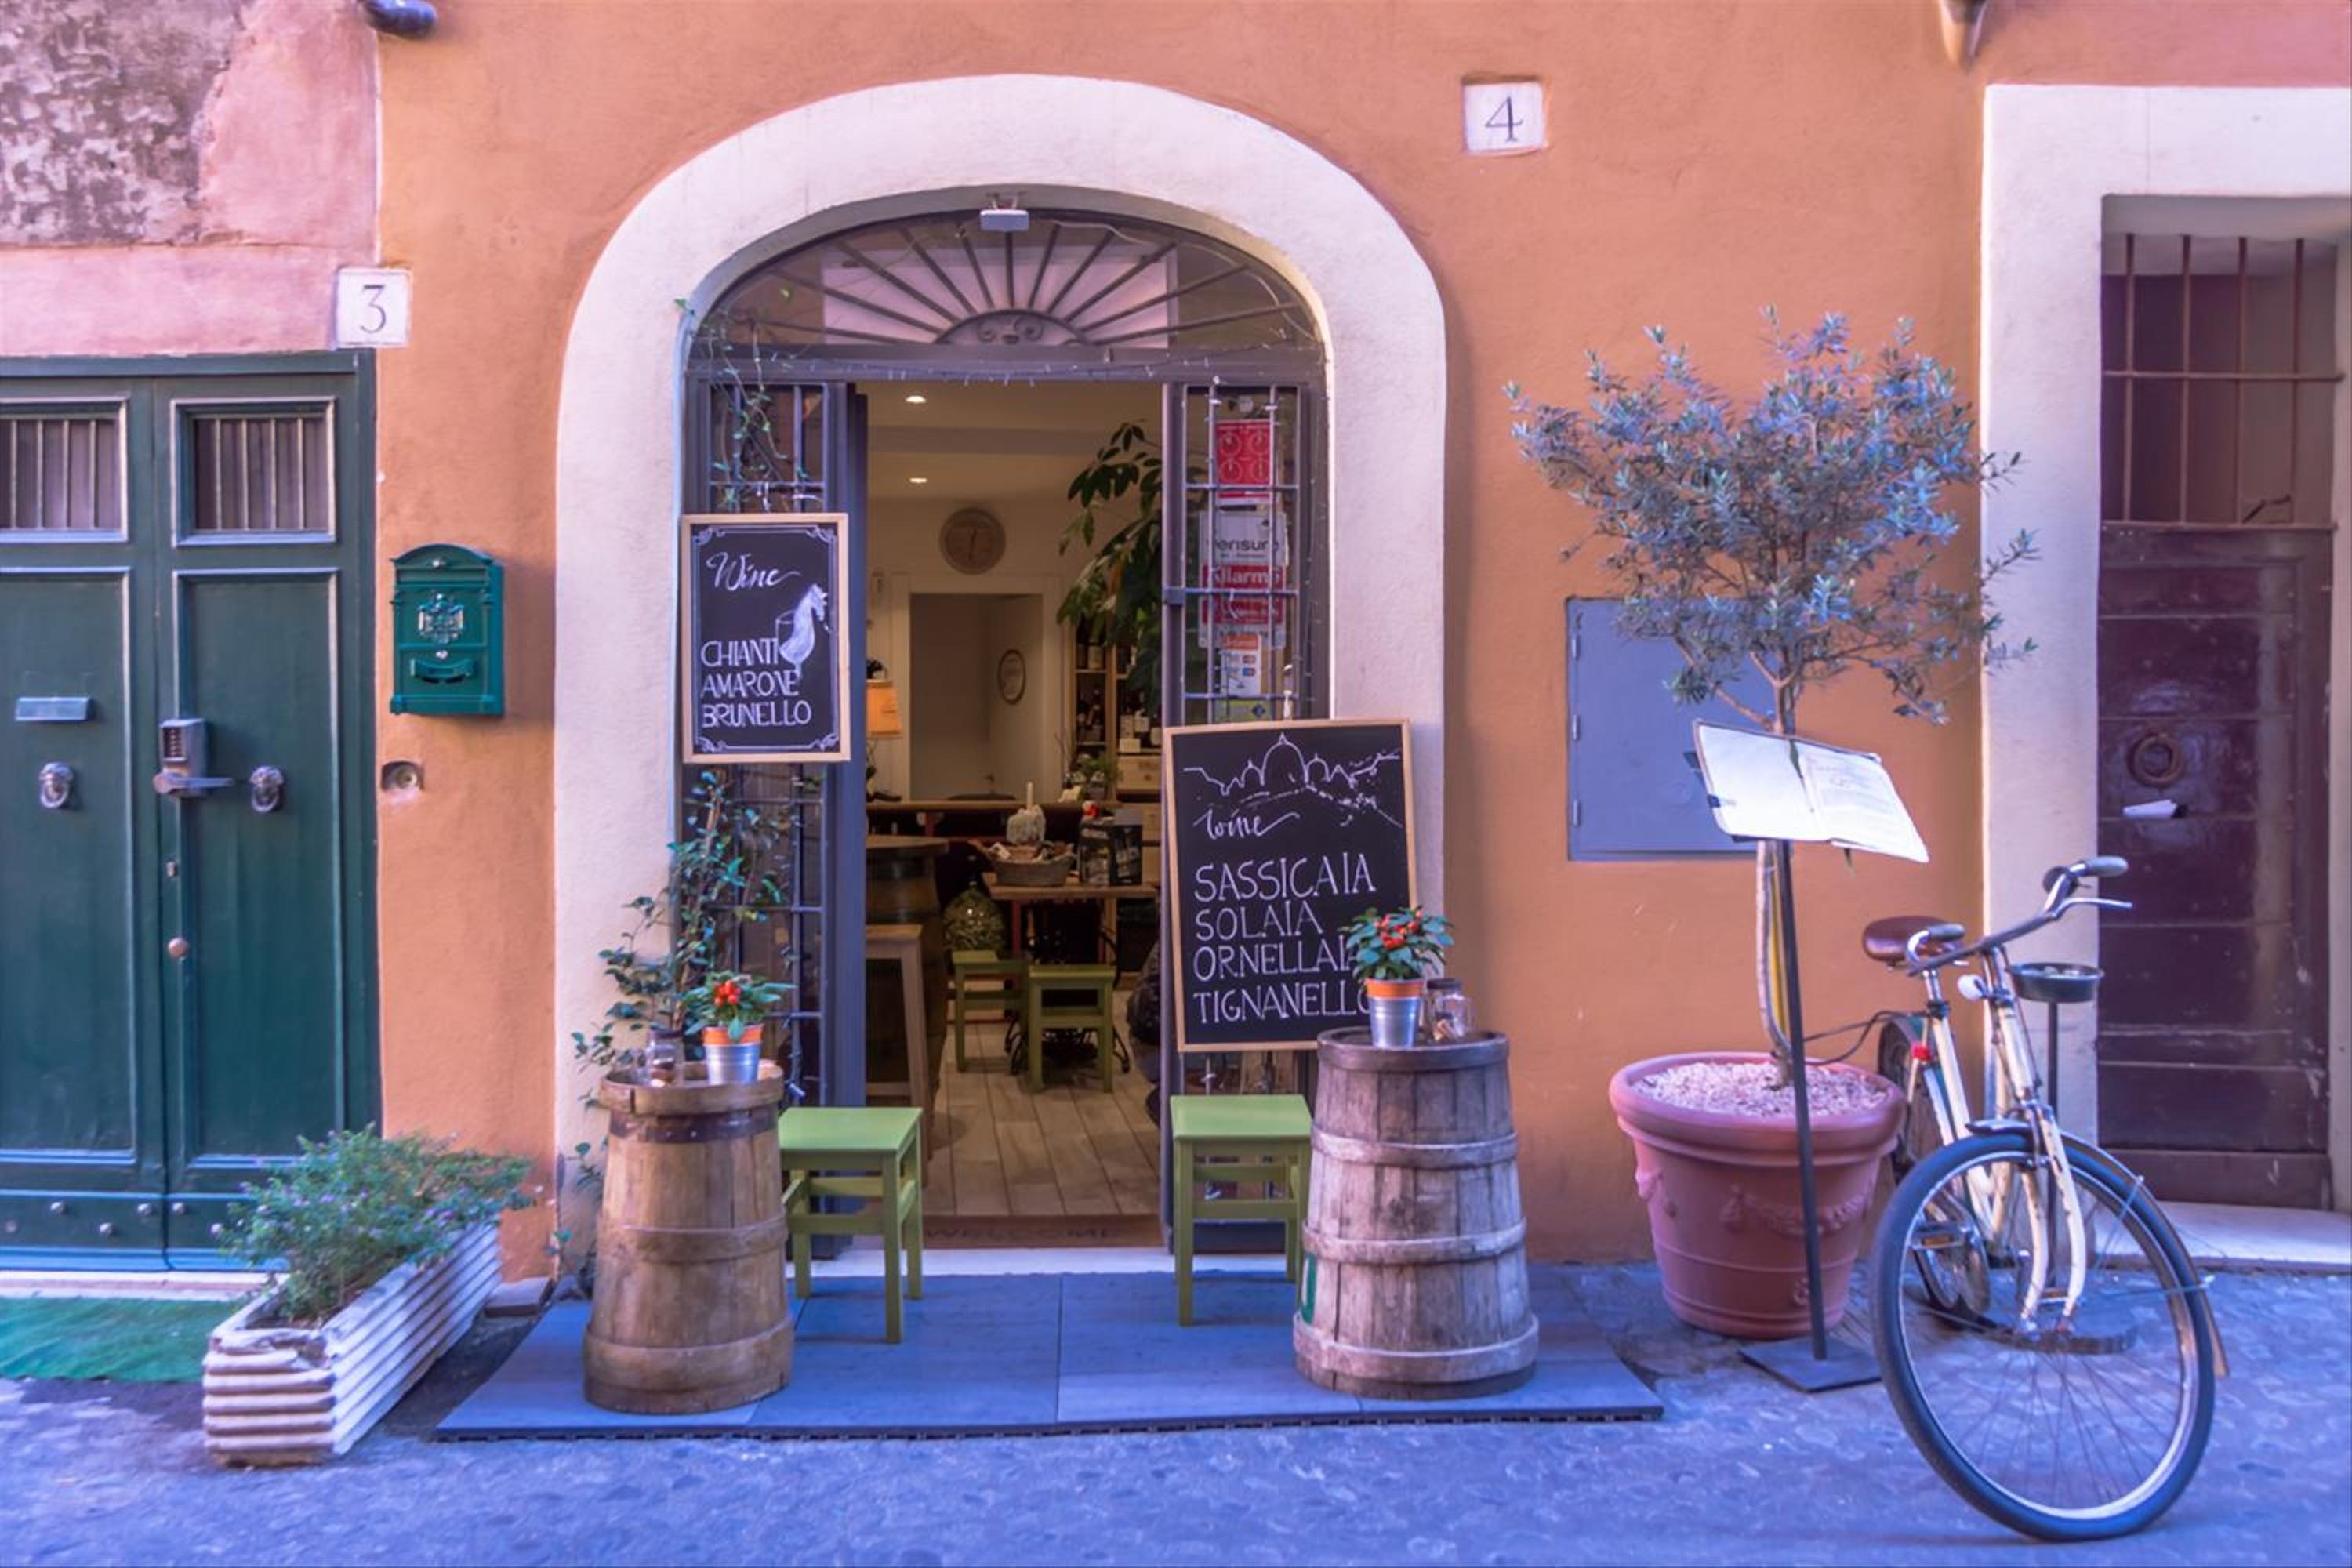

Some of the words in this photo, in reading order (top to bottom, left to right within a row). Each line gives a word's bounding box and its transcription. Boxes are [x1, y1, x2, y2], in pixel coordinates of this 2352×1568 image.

[1485, 96, 1523, 142] 4
[361, 284, 386, 334] 3
[706, 551, 801, 591] Wine
[701, 637, 779, 666] CHIANTI
[701, 670, 800, 698] AMARONE
[702, 700, 812, 728] BRUNELLO
[1194, 851, 1377, 902] SASSICAIA
[1196, 900, 1323, 941] SOLAIA
